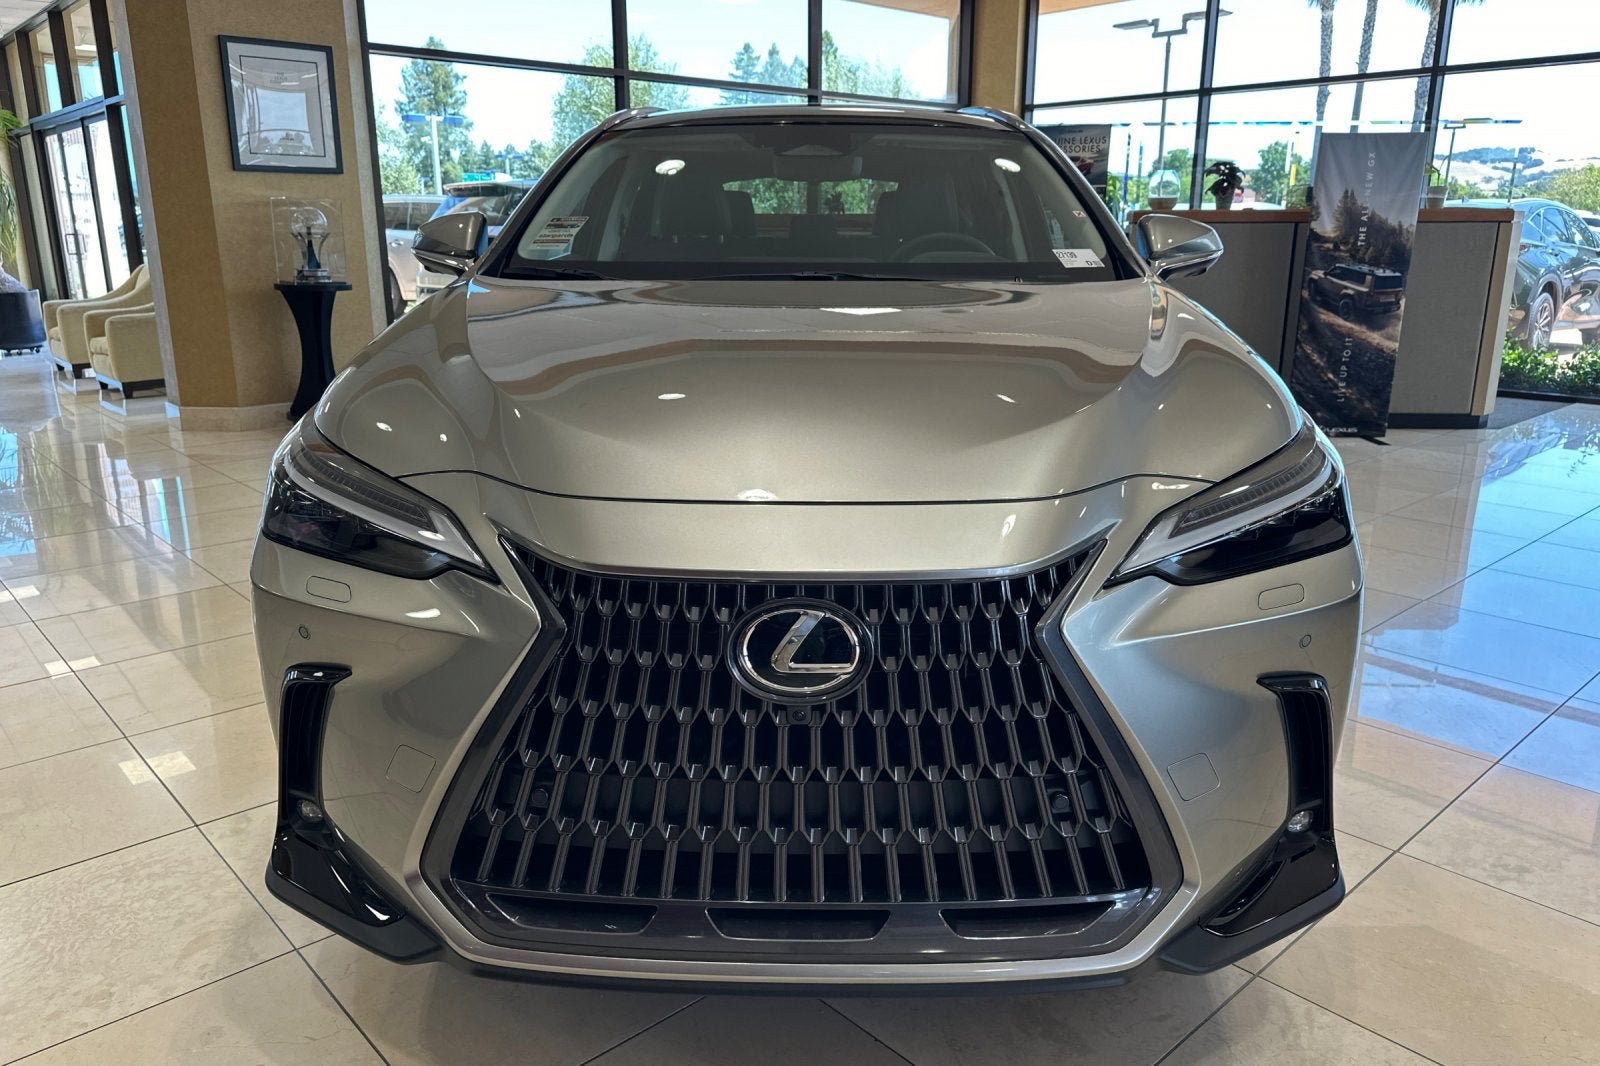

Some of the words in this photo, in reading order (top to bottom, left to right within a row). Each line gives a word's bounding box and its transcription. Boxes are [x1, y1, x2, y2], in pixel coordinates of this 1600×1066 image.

[1055, 136, 1076, 145] UINE
[1080, 135, 1106, 145] LEXUS
[1358, 226, 1367, 246] THE
[1367, 152, 1376, 168] GX
[1345, 337, 1353, 346] IT
[1342, 349, 1352, 362] TO
[1340, 364, 1348, 378] UP
[1337, 381, 1346, 402] LIVE
